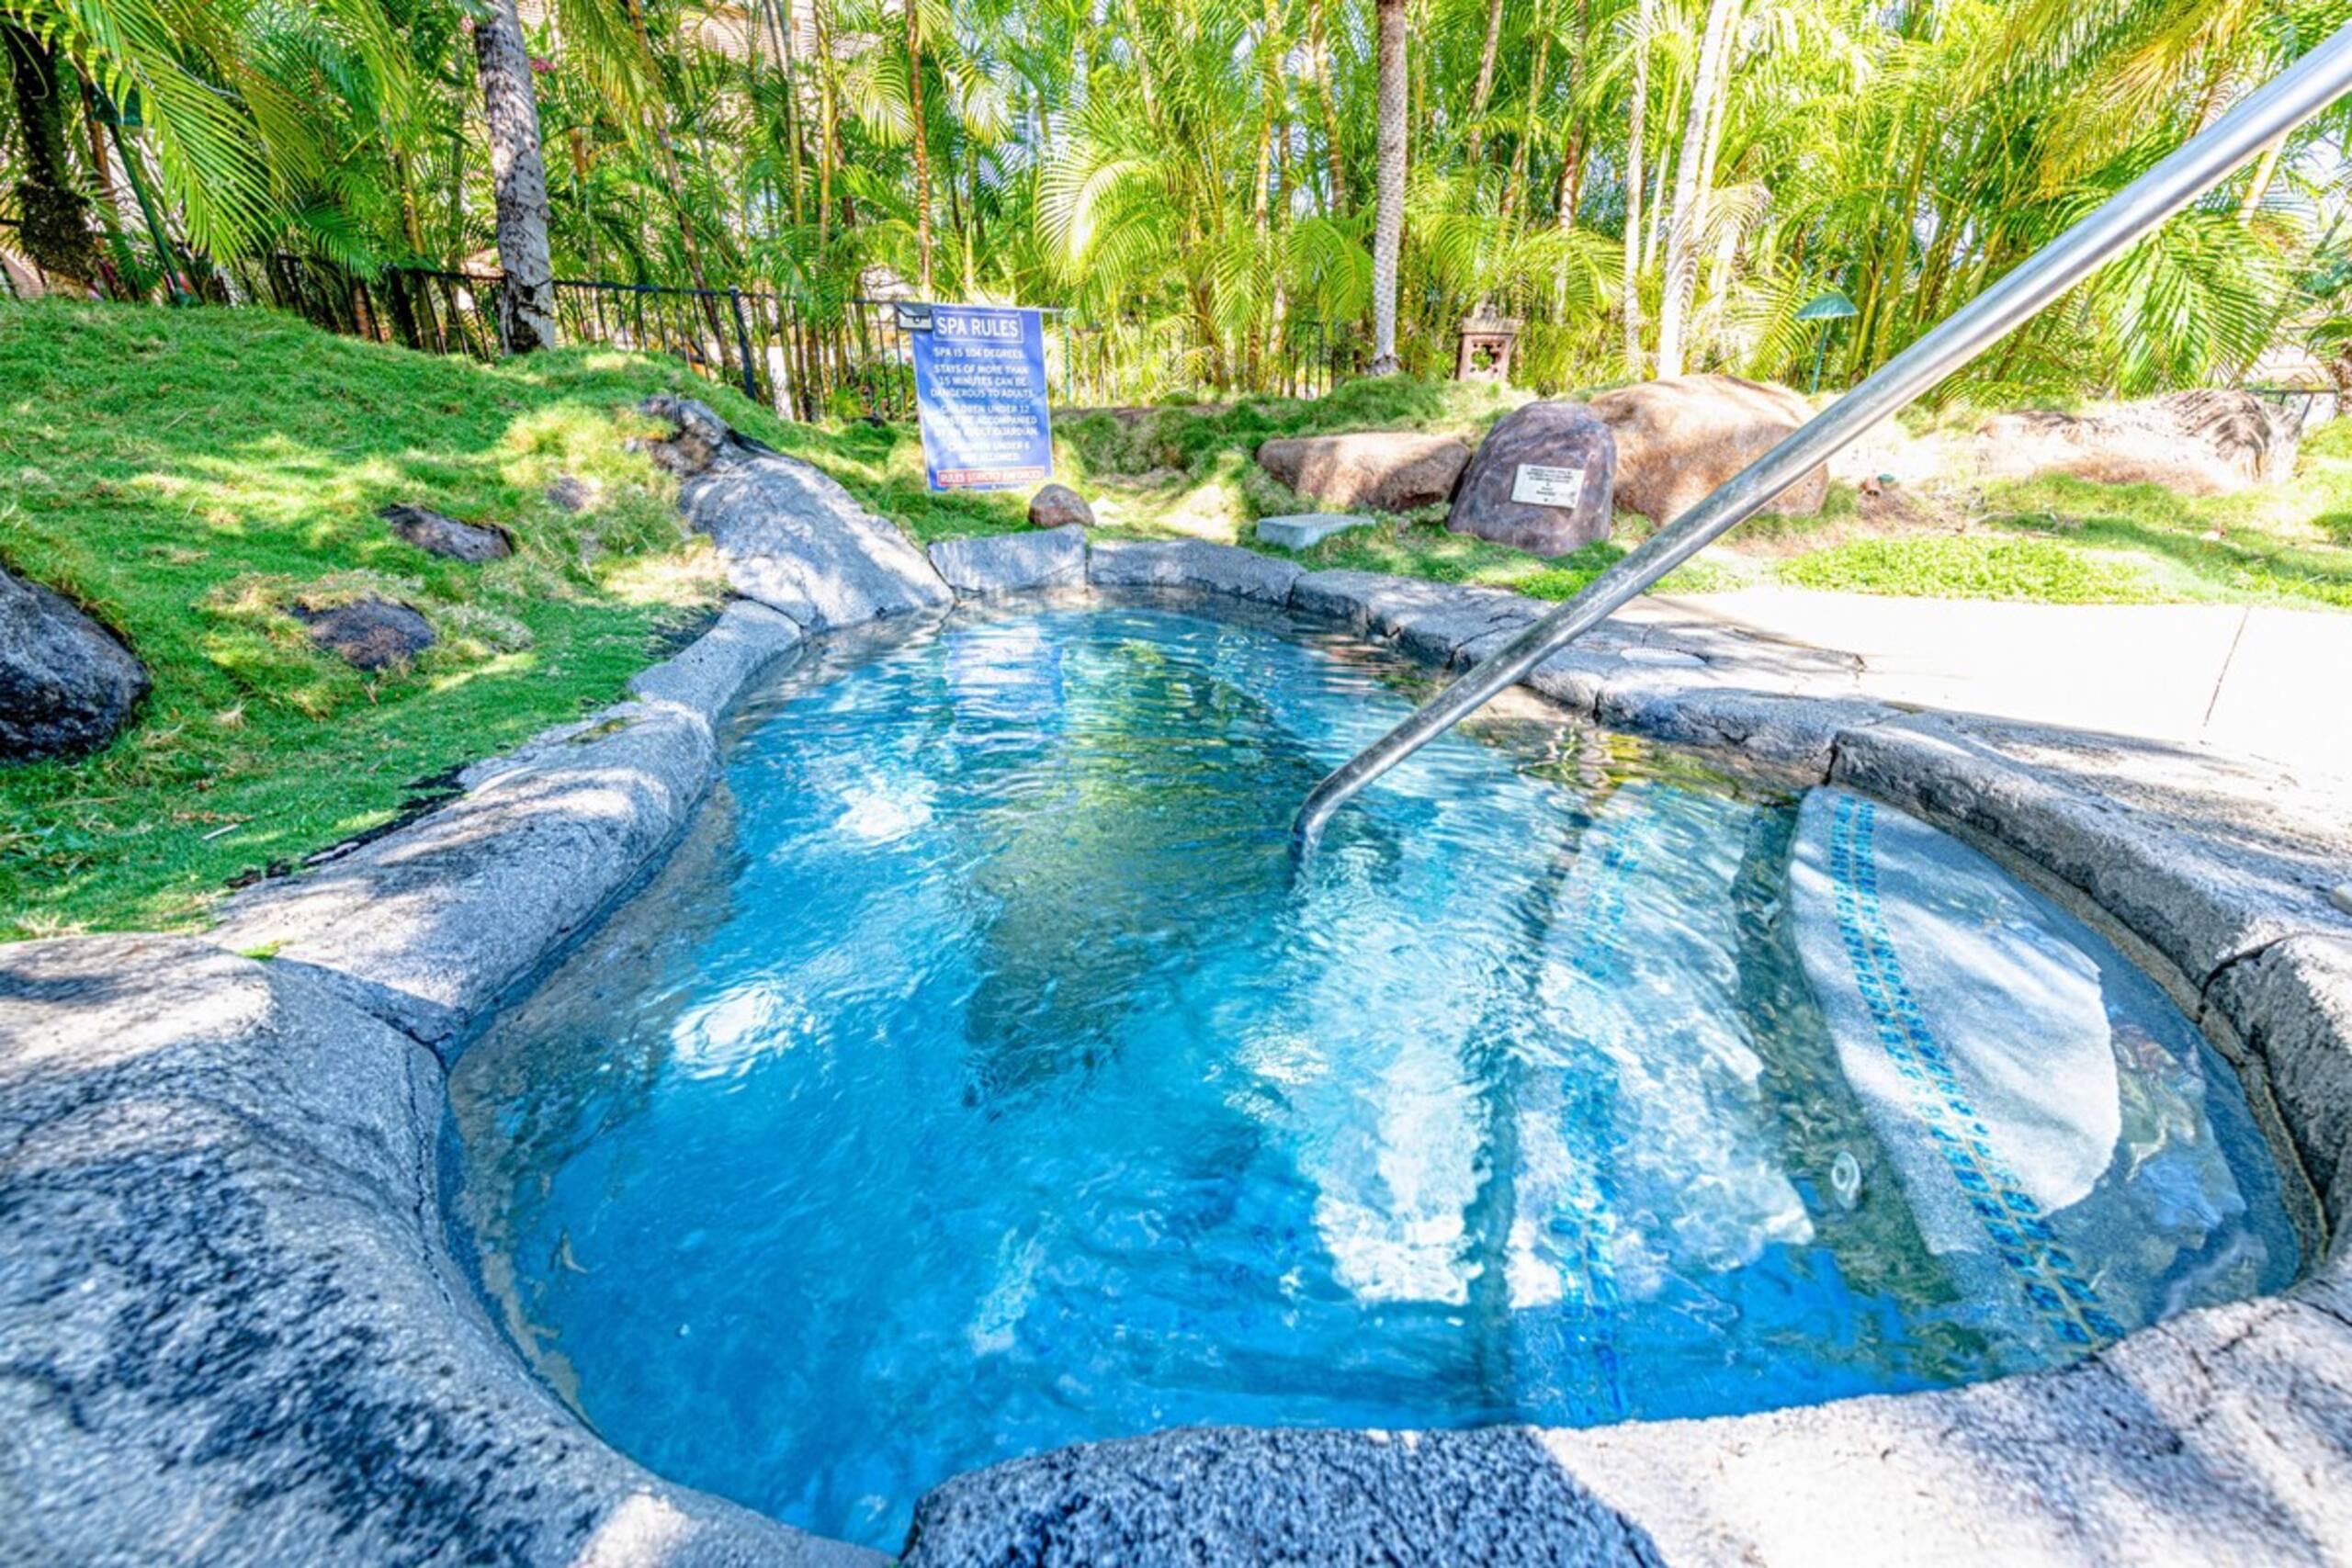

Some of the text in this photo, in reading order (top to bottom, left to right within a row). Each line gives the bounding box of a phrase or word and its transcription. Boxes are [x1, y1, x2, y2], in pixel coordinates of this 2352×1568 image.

[936, 316, 1019, 337] SPA RULES
[933, 346, 952, 357] SPA
[954, 347, 964, 357] IS
[933, 364, 1029, 375] STAYS OF MORE THAN
[952, 377, 992, 386] MINUTES
[995, 378, 1013, 386] CAN
[1015, 378, 1027, 387] BE
[931, 388, 985, 398] DANGEROUS
[987, 389, 1000, 397] TO
[988, 404, 1017, 413] UNDER
[1020, 405, 1030, 413] 12
[978, 415, 1037, 424] ACCOMPANIED
